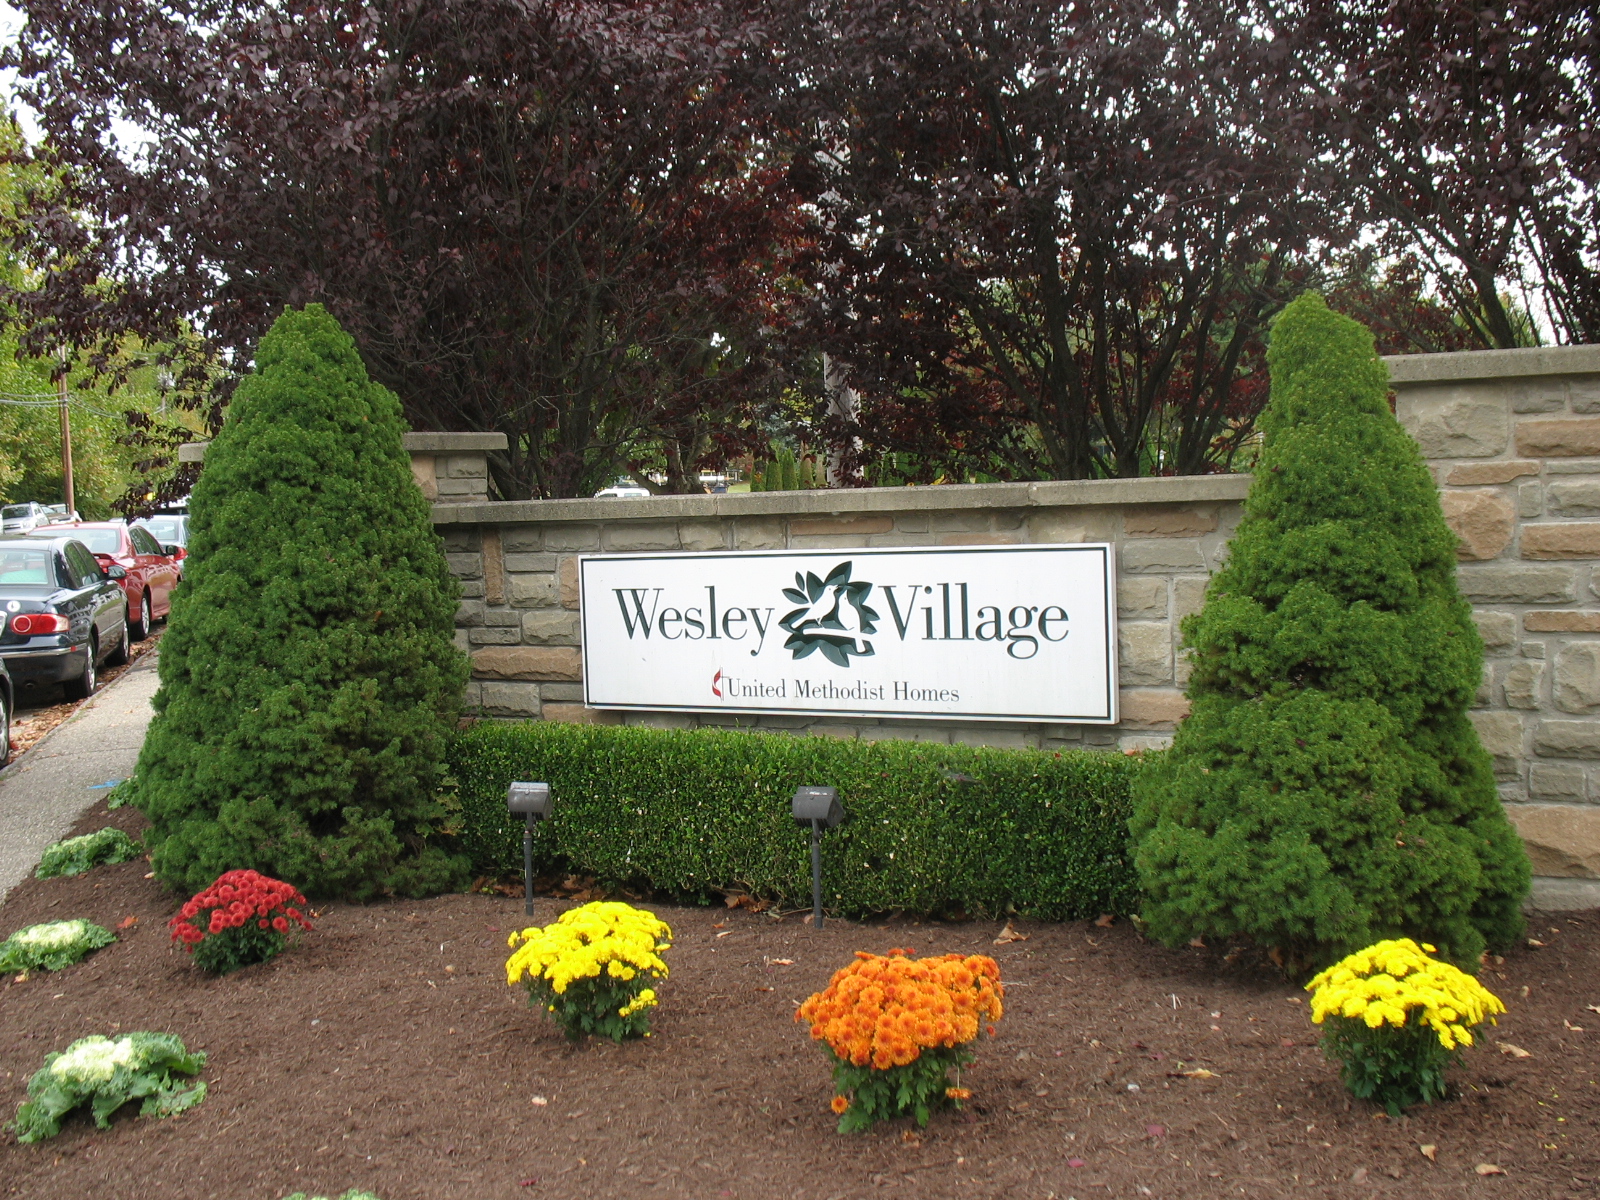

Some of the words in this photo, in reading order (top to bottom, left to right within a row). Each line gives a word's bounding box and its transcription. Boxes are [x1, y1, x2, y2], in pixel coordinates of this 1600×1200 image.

[611, 585, 775, 656] Wesley
[877, 582, 1070, 660] Village
[727, 678, 786, 698] United
[794, 679, 886, 701] Methodist
[893, 681, 960, 703] Homes
